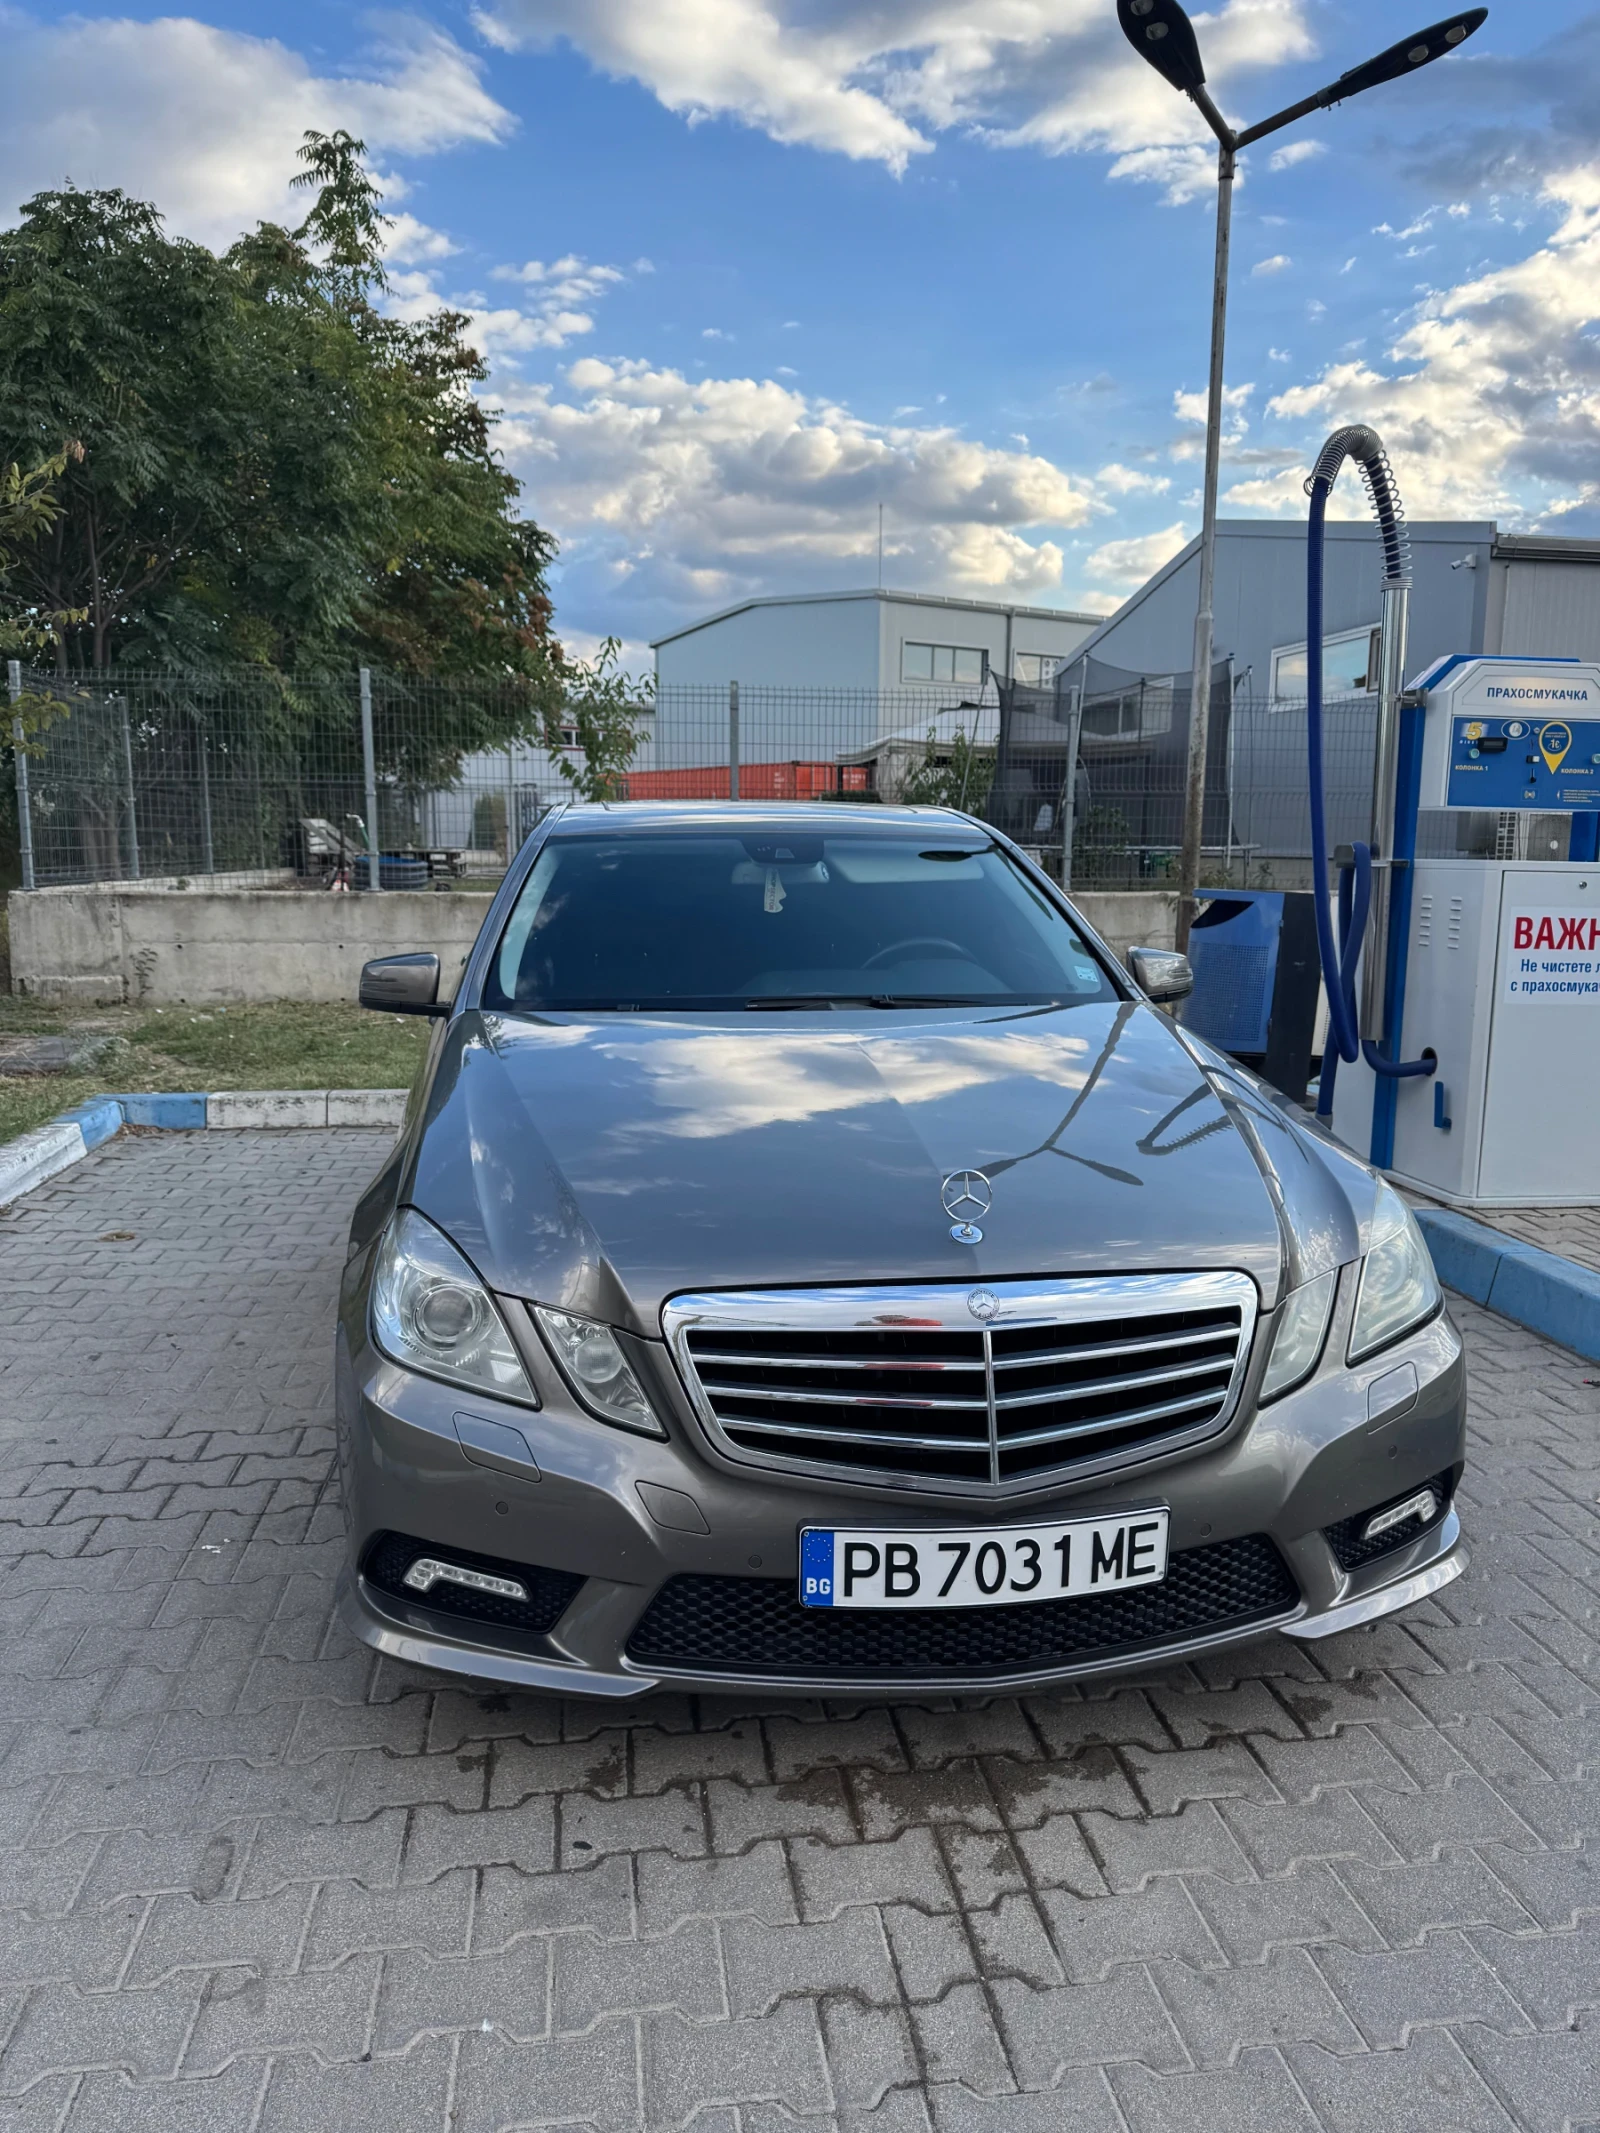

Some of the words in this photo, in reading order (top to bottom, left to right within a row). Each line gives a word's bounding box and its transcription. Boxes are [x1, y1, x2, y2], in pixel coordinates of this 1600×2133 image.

[1487, 687, 1588, 700] ПРАХОСМУКАЧКА
[1466, 722, 1482, 740] 5
[1521, 959, 1537, 972] Не
[1542, 962, 1591, 973] чистете
[1510, 980, 1518, 992] с
[1522, 981, 1600, 995] прахосмука
[843, 1541, 921, 1598] PB
[937, 1532, 1072, 1598] 7031
[1090, 1521, 1160, 1584] ME
[806, 1577, 831, 1595] BG
